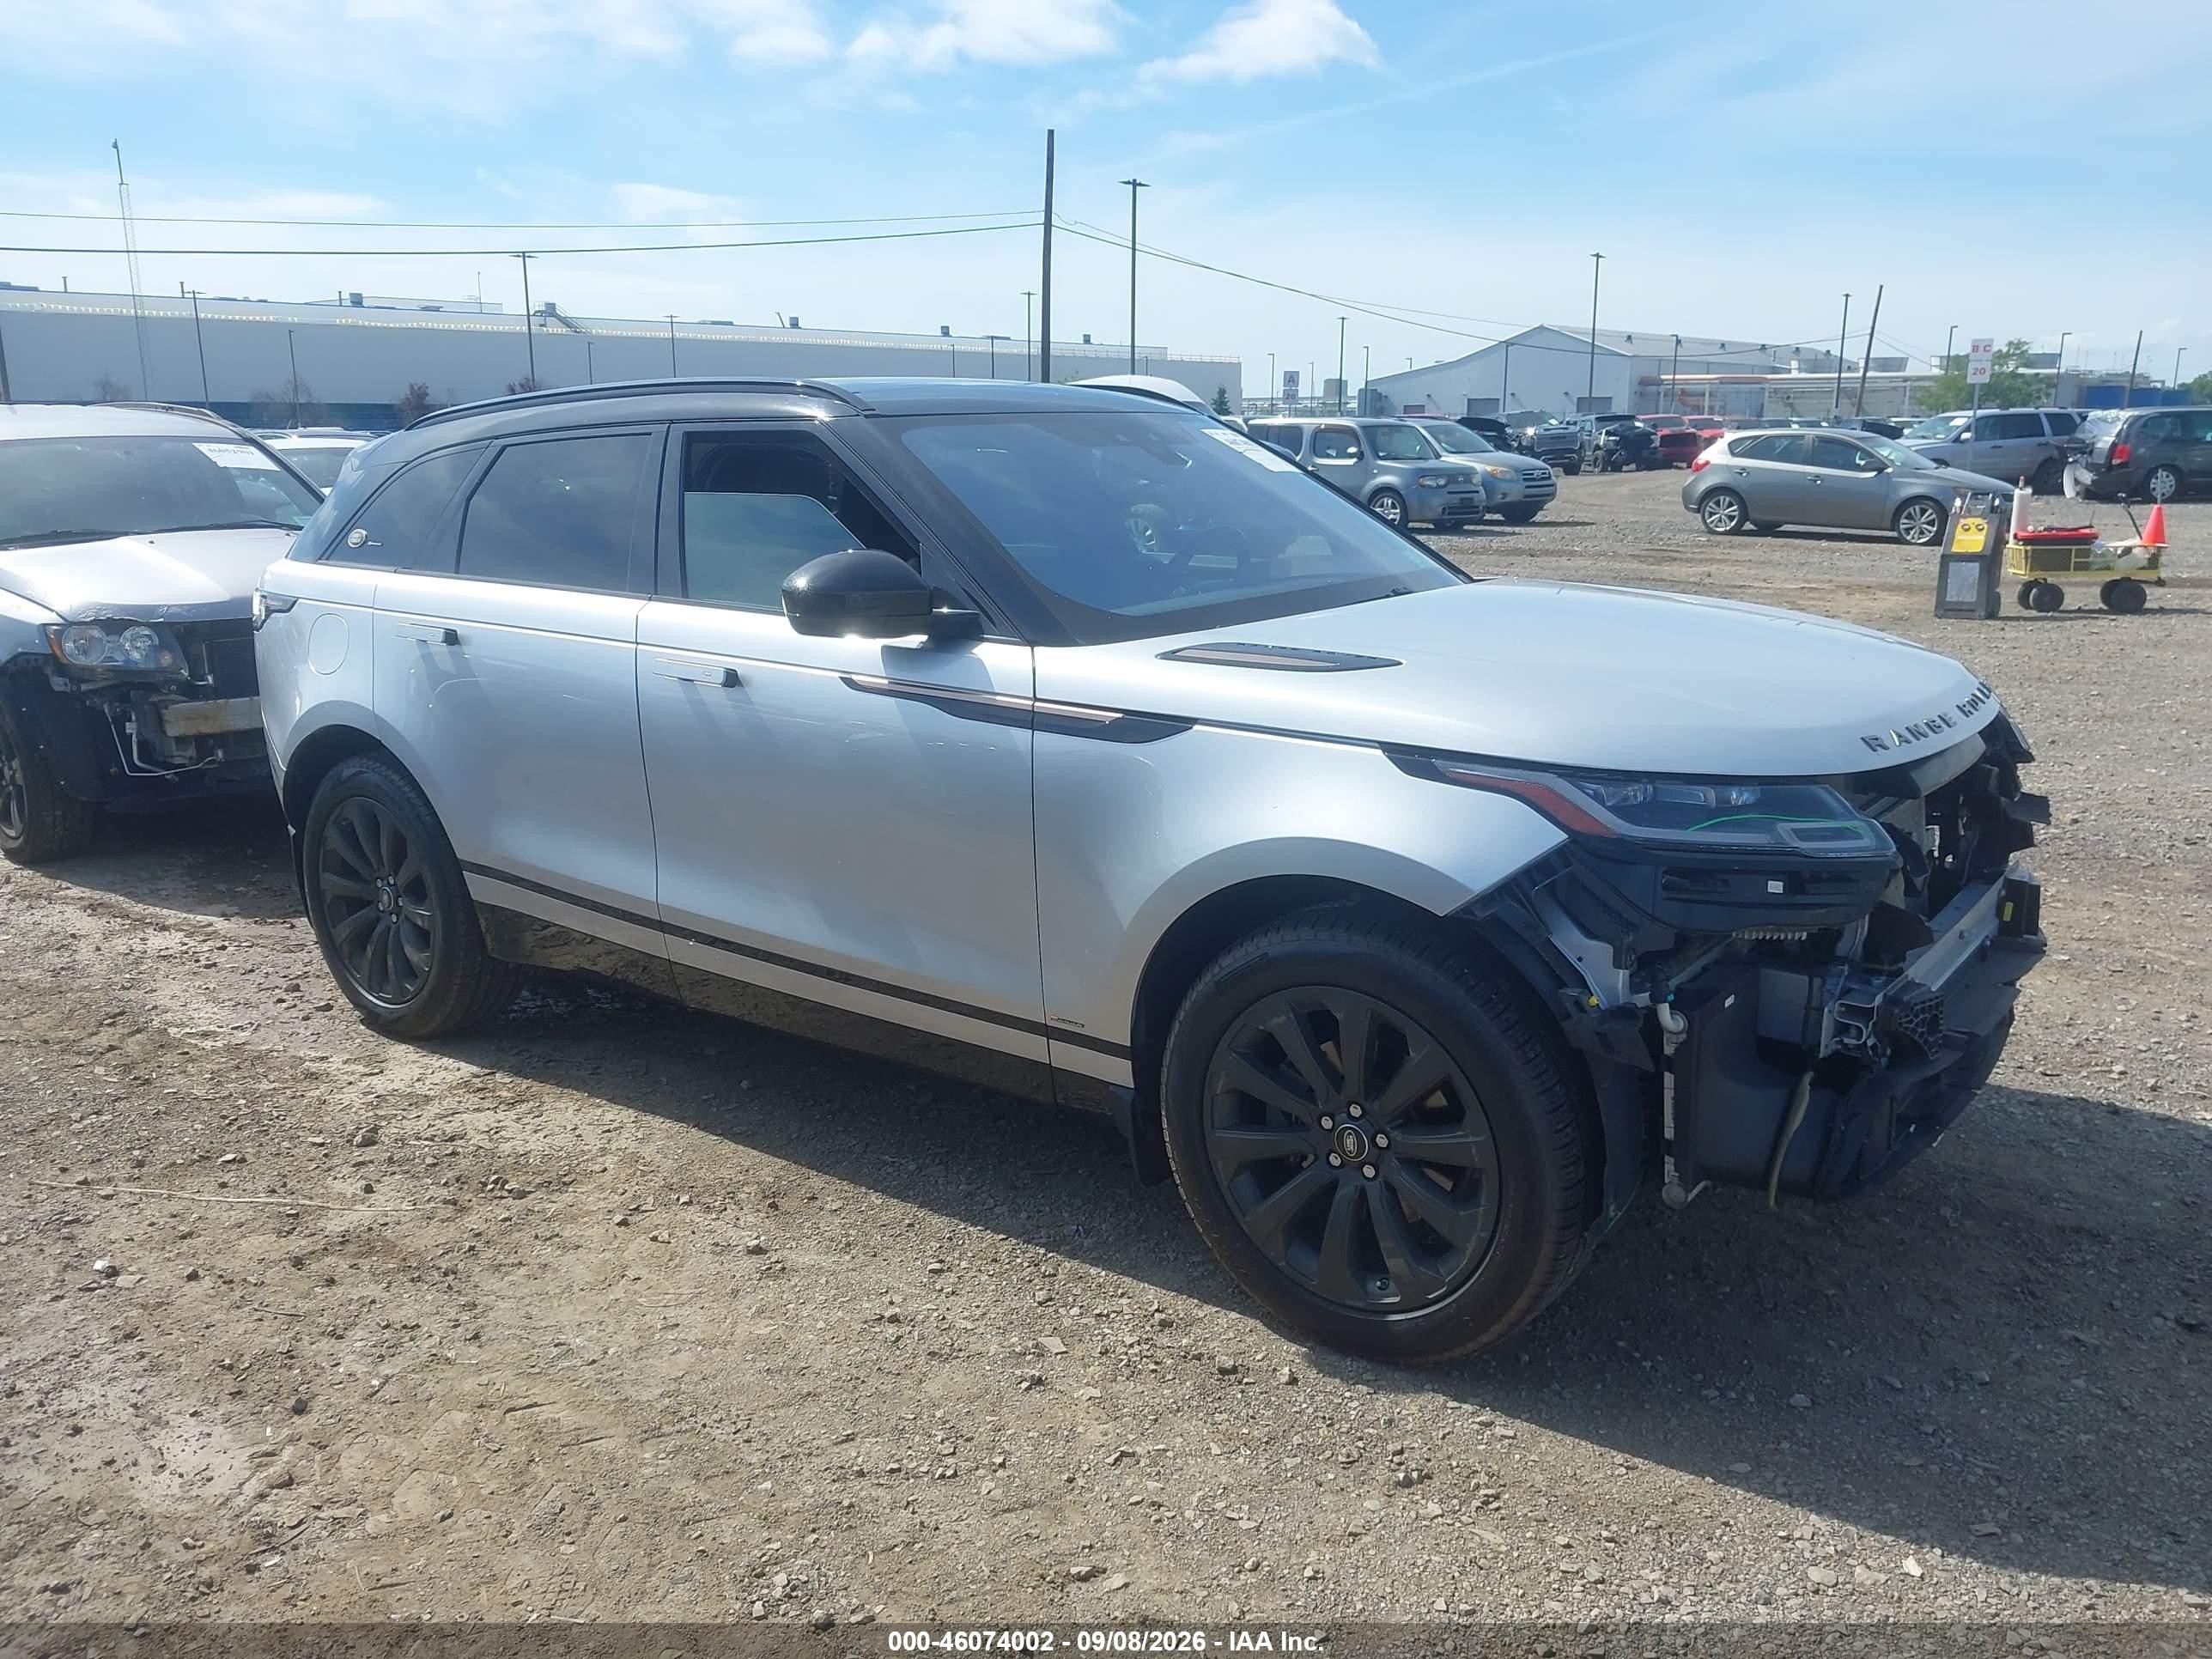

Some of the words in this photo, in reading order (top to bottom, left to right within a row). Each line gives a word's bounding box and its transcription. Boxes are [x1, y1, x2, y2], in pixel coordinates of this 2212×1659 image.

[1972, 344, 1979, 354] B
[1984, 343, 1992, 353] C
[1972, 367, 1986, 376] 20
[1287, 374, 1296, 385] A
[1285, 392, 1297, 401] 20
[1860, 712, 1958, 753] RANGE
